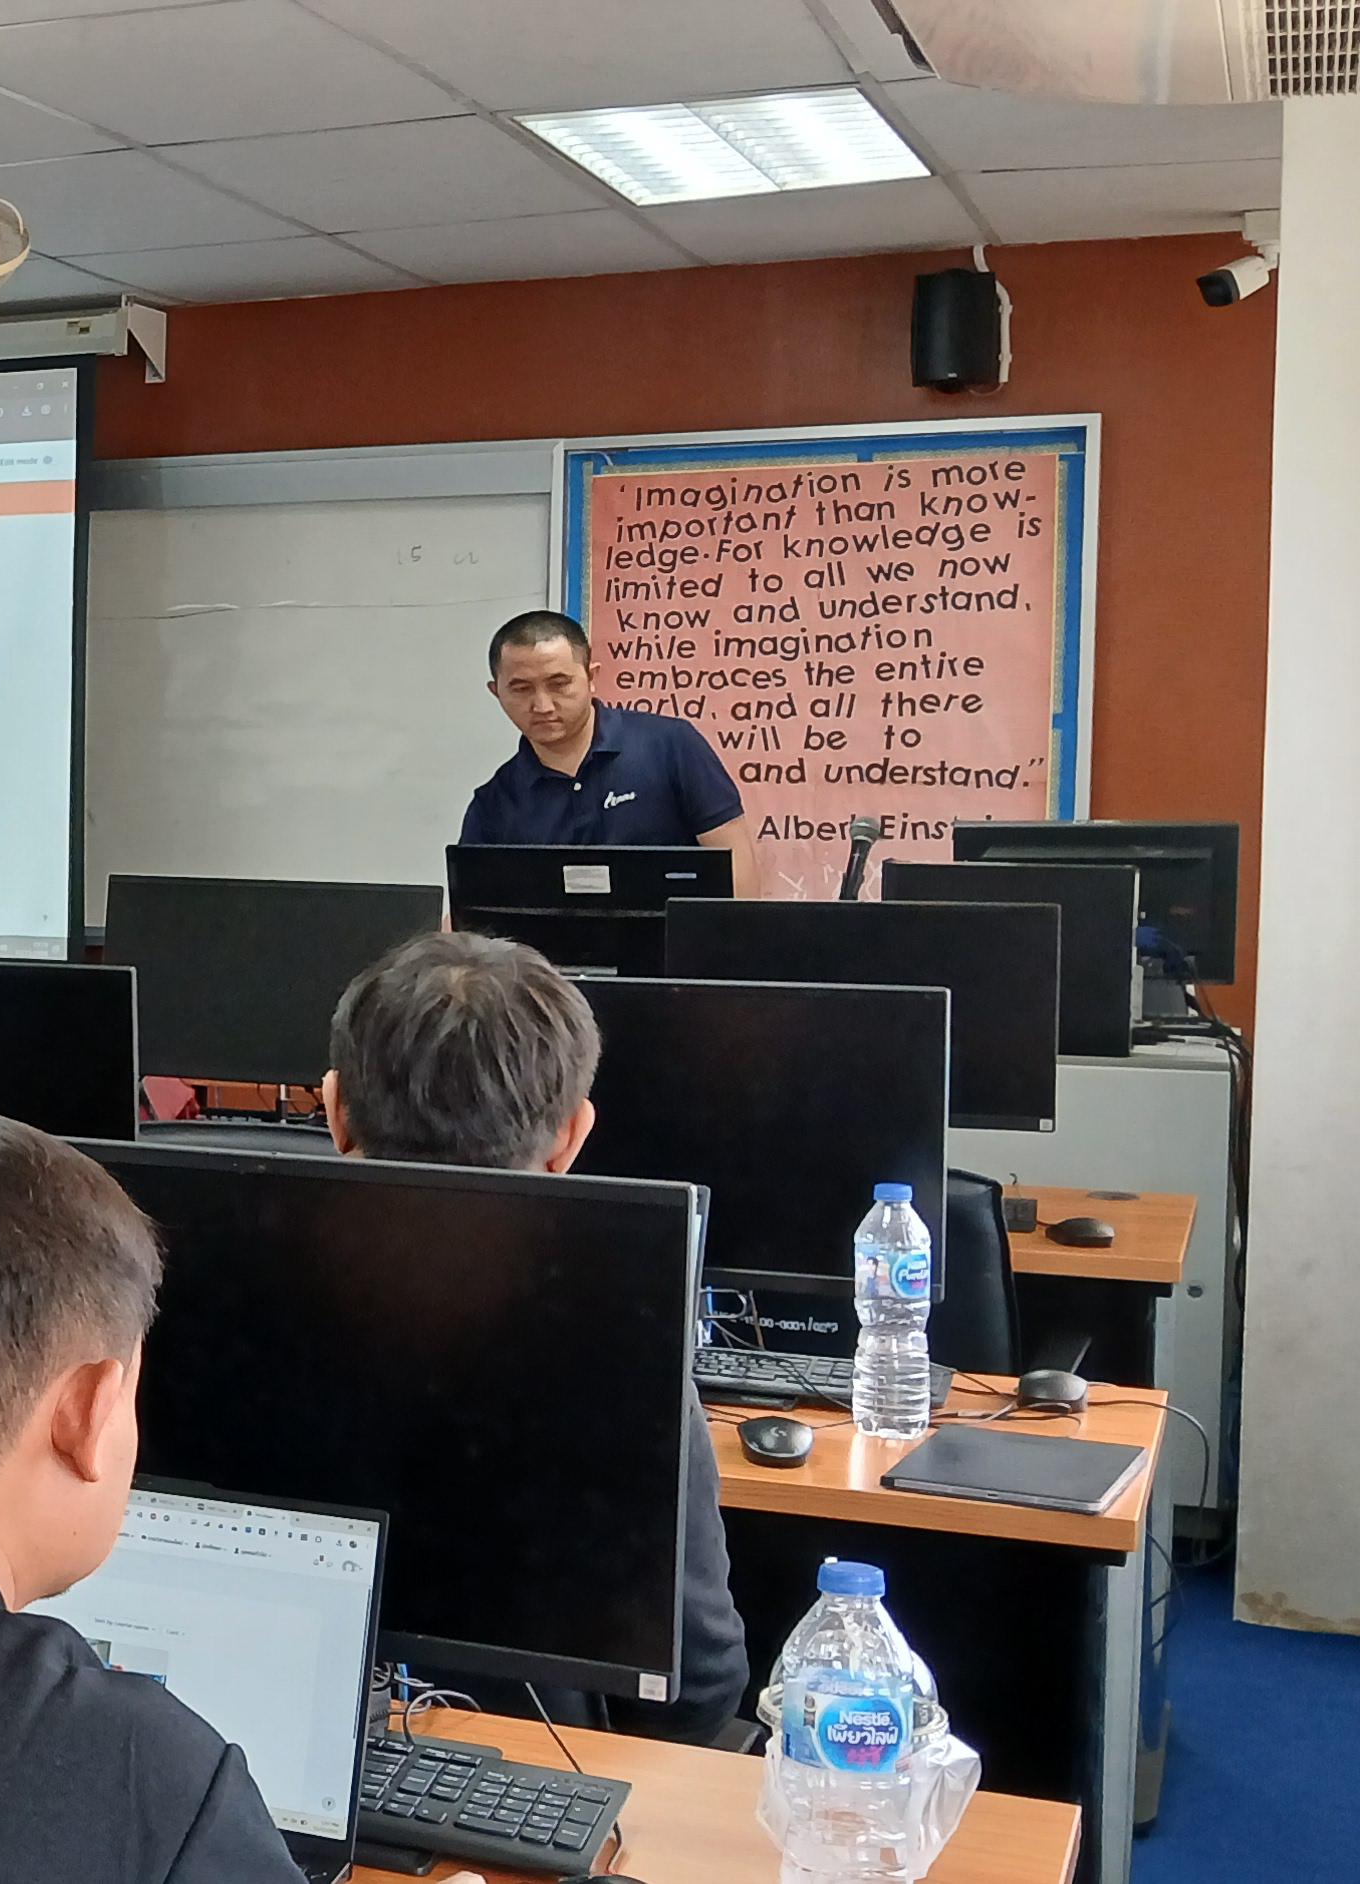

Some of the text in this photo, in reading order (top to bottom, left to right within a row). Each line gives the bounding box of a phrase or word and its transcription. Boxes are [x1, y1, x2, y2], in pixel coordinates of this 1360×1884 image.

[883, 466, 911, 492] is
[932, 460, 1025, 488] more
[616, 489, 1036, 543] important than know-
[783, 521, 992, 559] knowledge
[1018, 515, 1041, 538] is
[605, 554, 1011, 601] limited to all we now
[618, 609, 710, 632] know
[733, 598, 800, 624] and
[607, 626, 933, 662] while imagination
[616, 655, 985, 691] embraces the entire
[607, 691, 983, 721] orld, and all there
[718, 725, 921, 752] will be to
[739, 759, 806, 784] and
